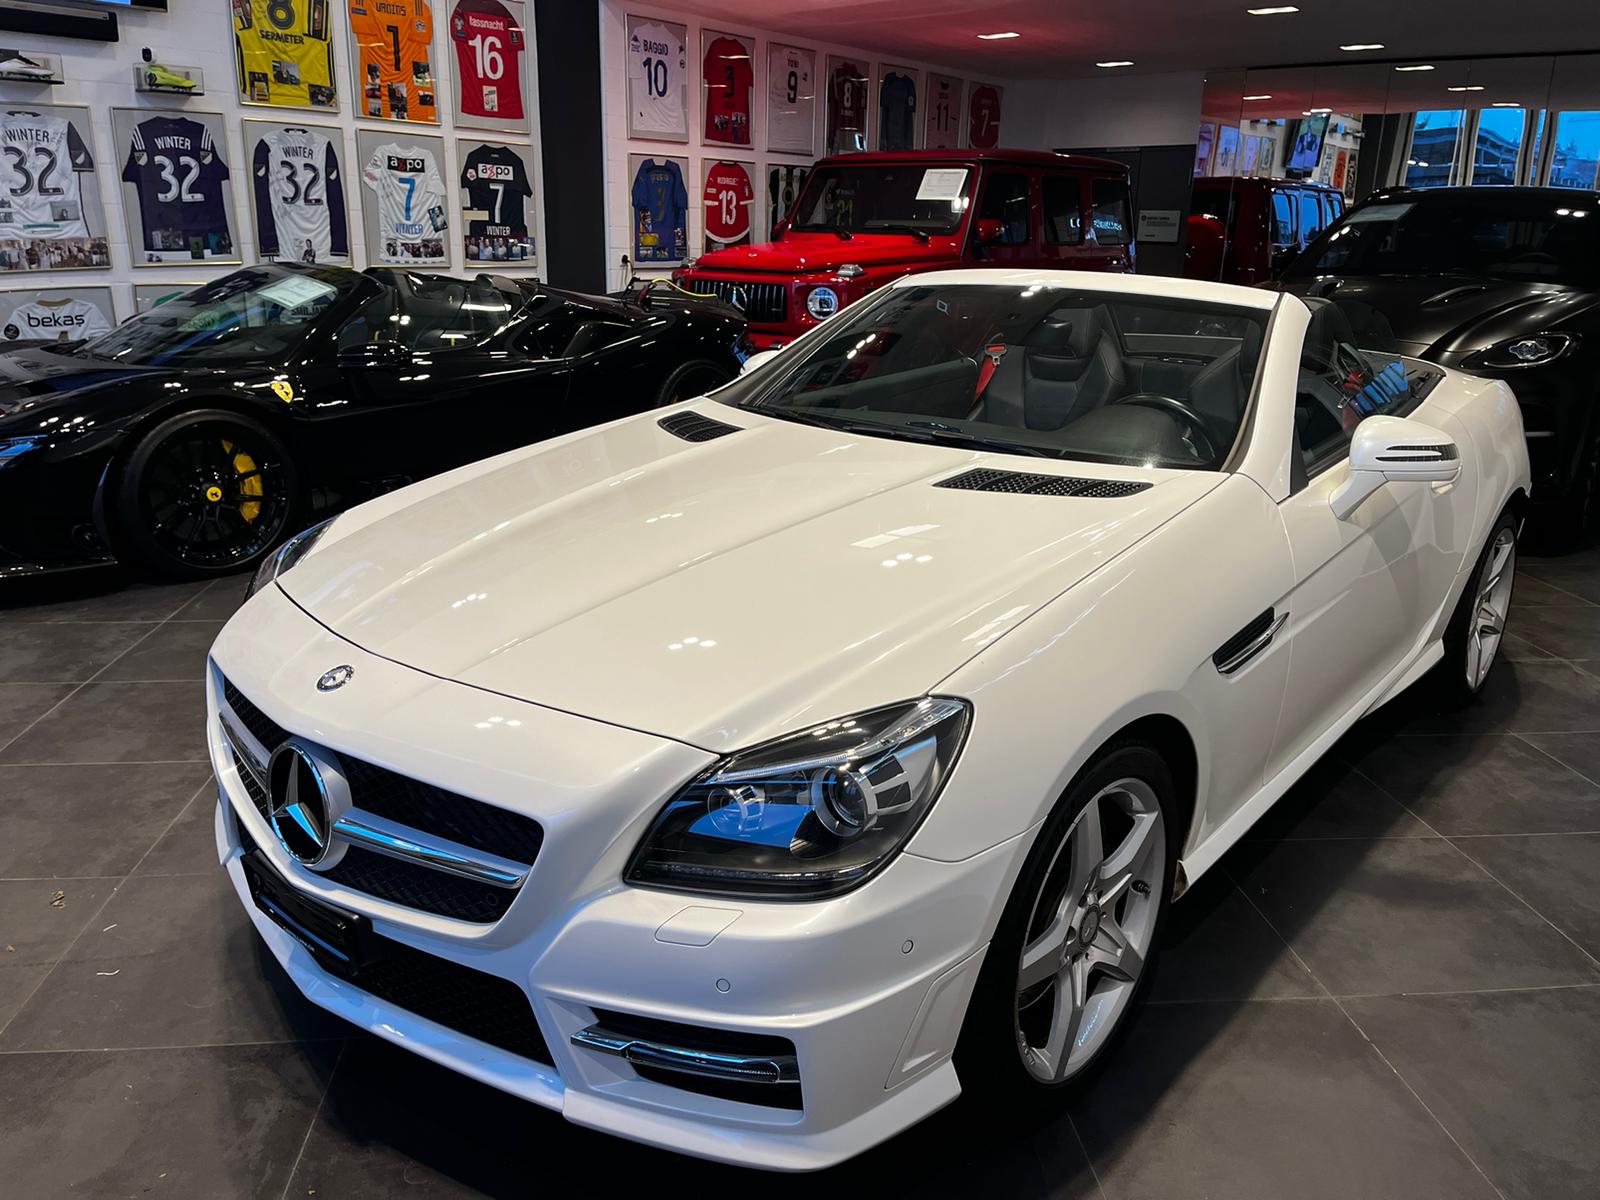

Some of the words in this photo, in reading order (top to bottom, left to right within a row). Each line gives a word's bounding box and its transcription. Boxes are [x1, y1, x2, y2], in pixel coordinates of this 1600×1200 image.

[386, 25, 401, 71] 1
[468, 34, 504, 80] 16
[643, 39, 669, 56] BAGGIO
[642, 57, 668, 97] 10
[787, 71, 798, 103] 9
[843, 82, 852, 108] 8
[937, 103, 949, 132] 11
[981, 108, 990, 136] 7
[6, 128, 50, 142] WINTER
[154, 136, 191, 150] WINTER
[282, 146, 314, 159] WINTER
[4, 146, 64, 196] 32
[154, 155, 204, 202] 32
[281, 160, 323, 206] 32
[397, 177, 415, 221] 7
[489, 183, 504, 223] 7
[718, 190, 737, 225] 13
[395, 223, 424, 235] WINTER
[486, 226, 511, 236] WINTER
[27, 312, 86, 328] bekaş
